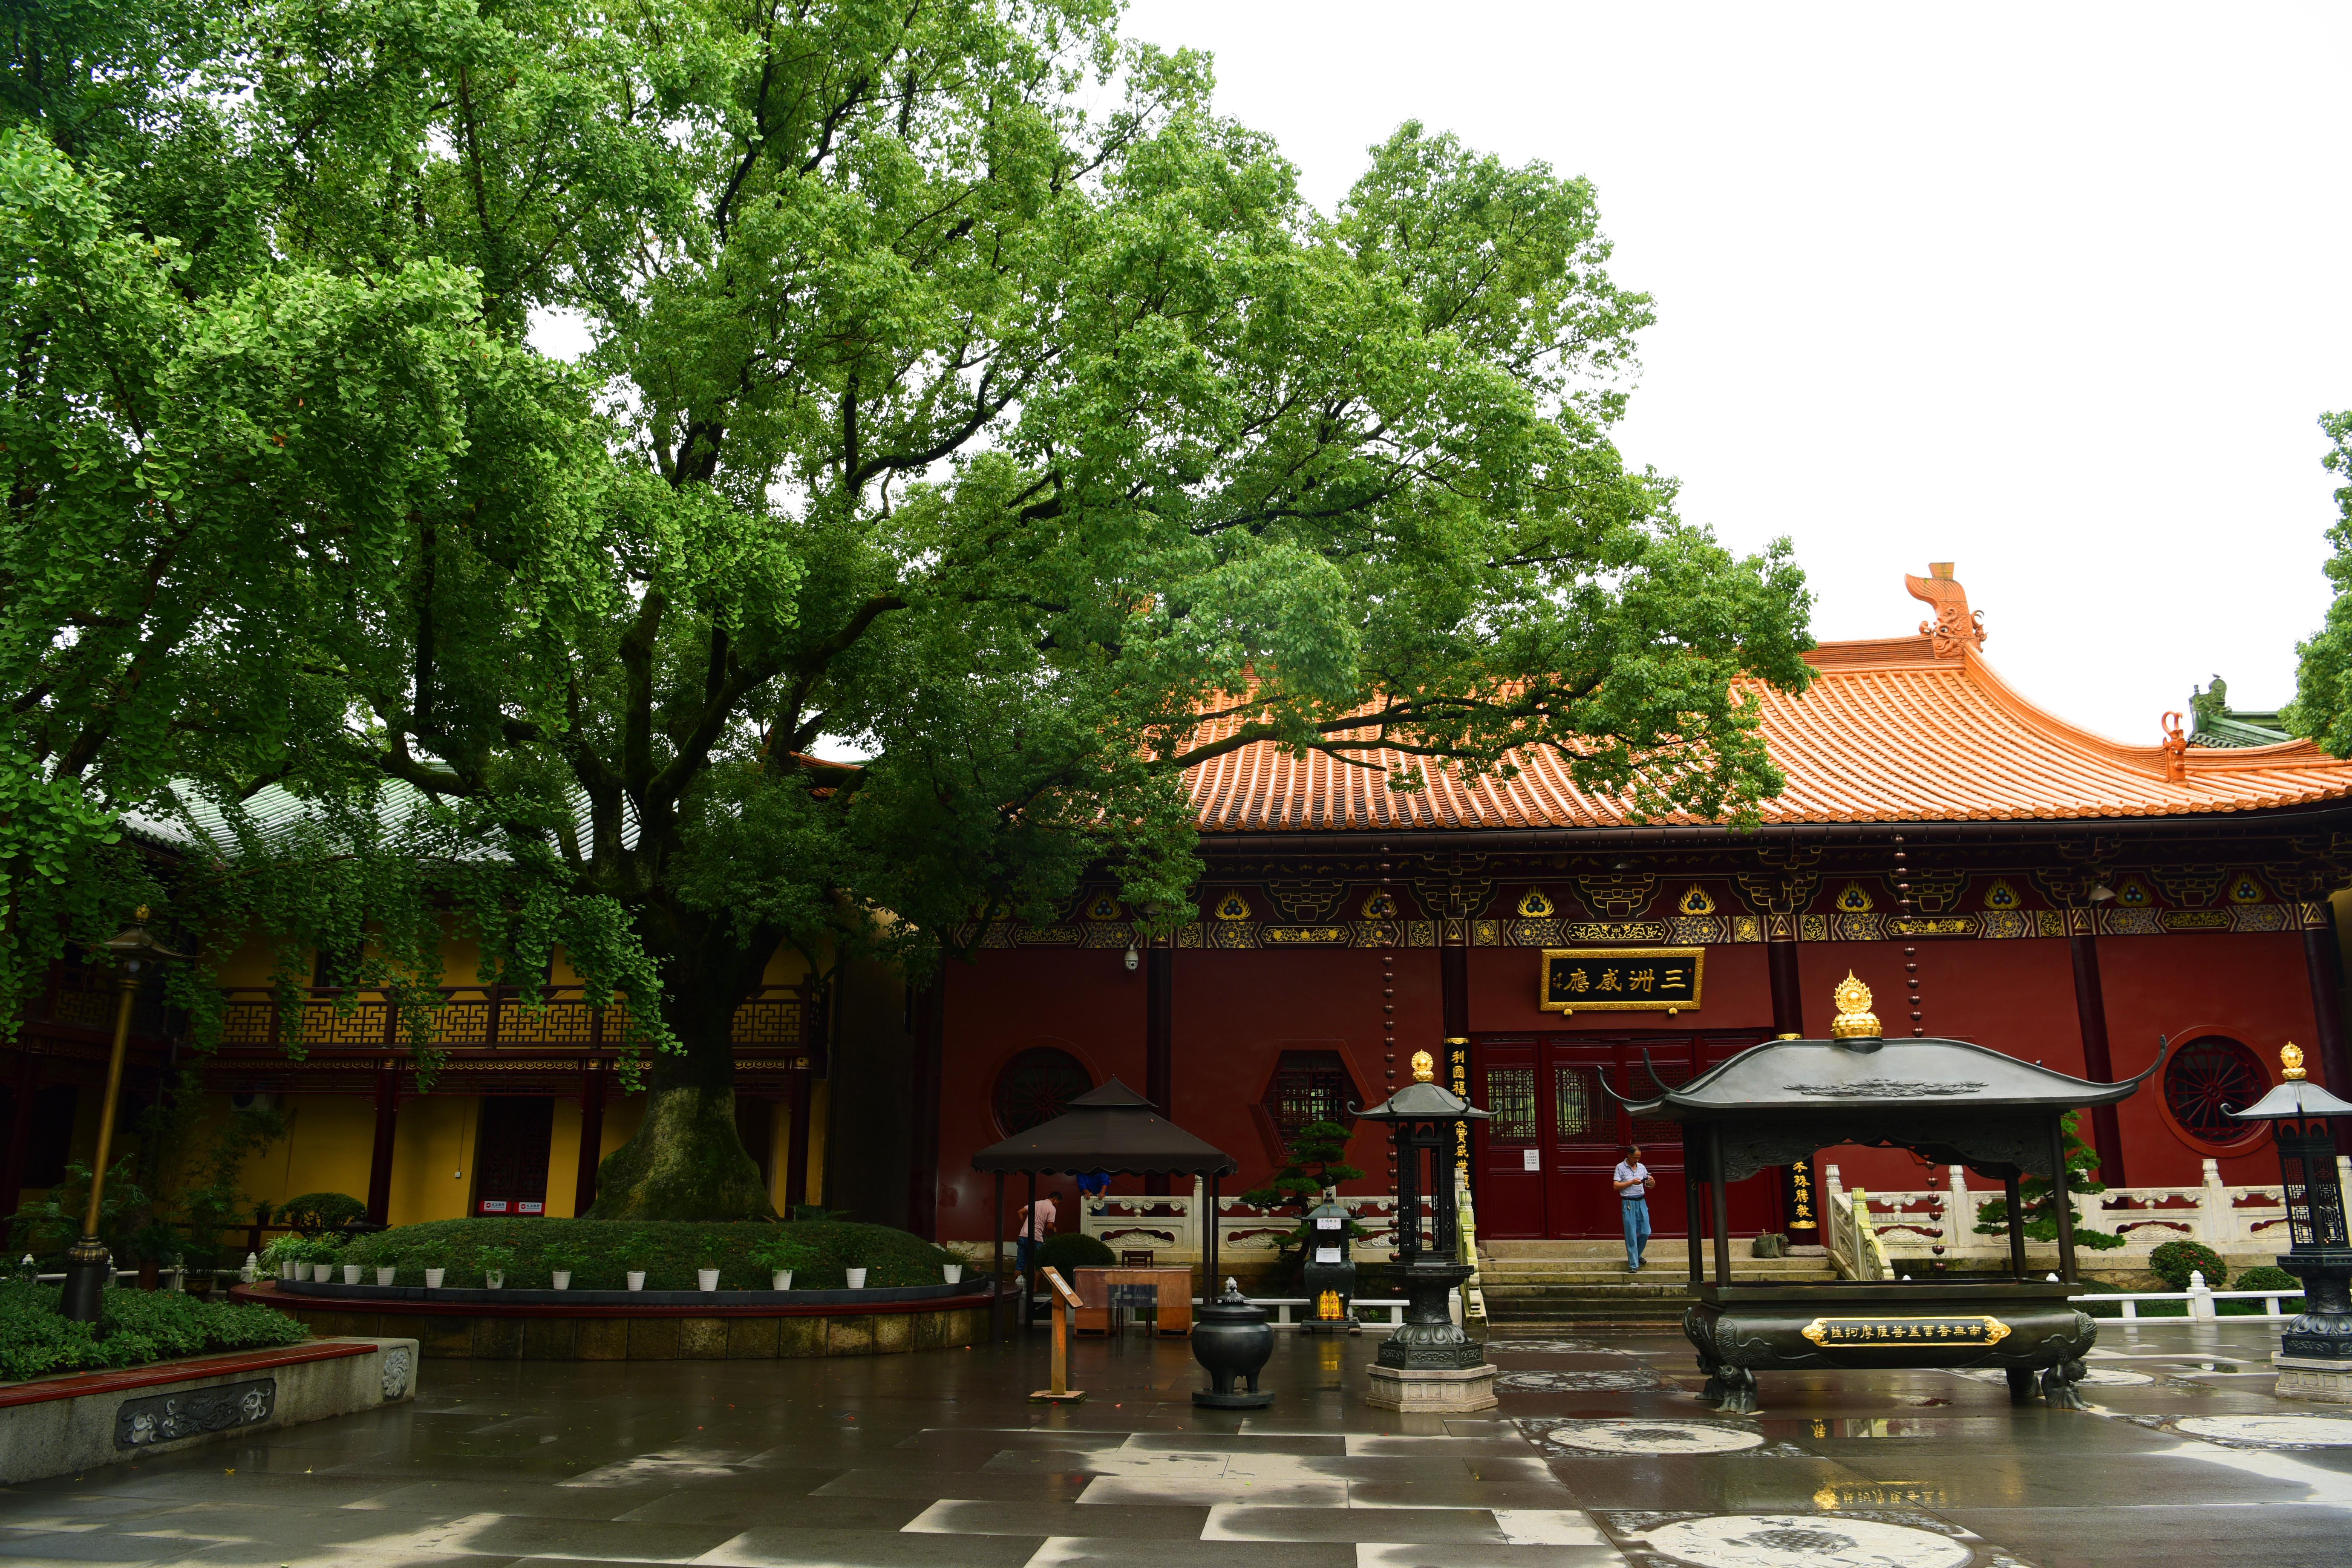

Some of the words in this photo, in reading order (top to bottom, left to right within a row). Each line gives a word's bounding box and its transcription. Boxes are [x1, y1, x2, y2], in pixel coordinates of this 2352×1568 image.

[1563, 968, 1686, 993] 三洲感應
[1830, 1324, 1982, 1339] 南無香雲蓋菩薩摩訶薩
